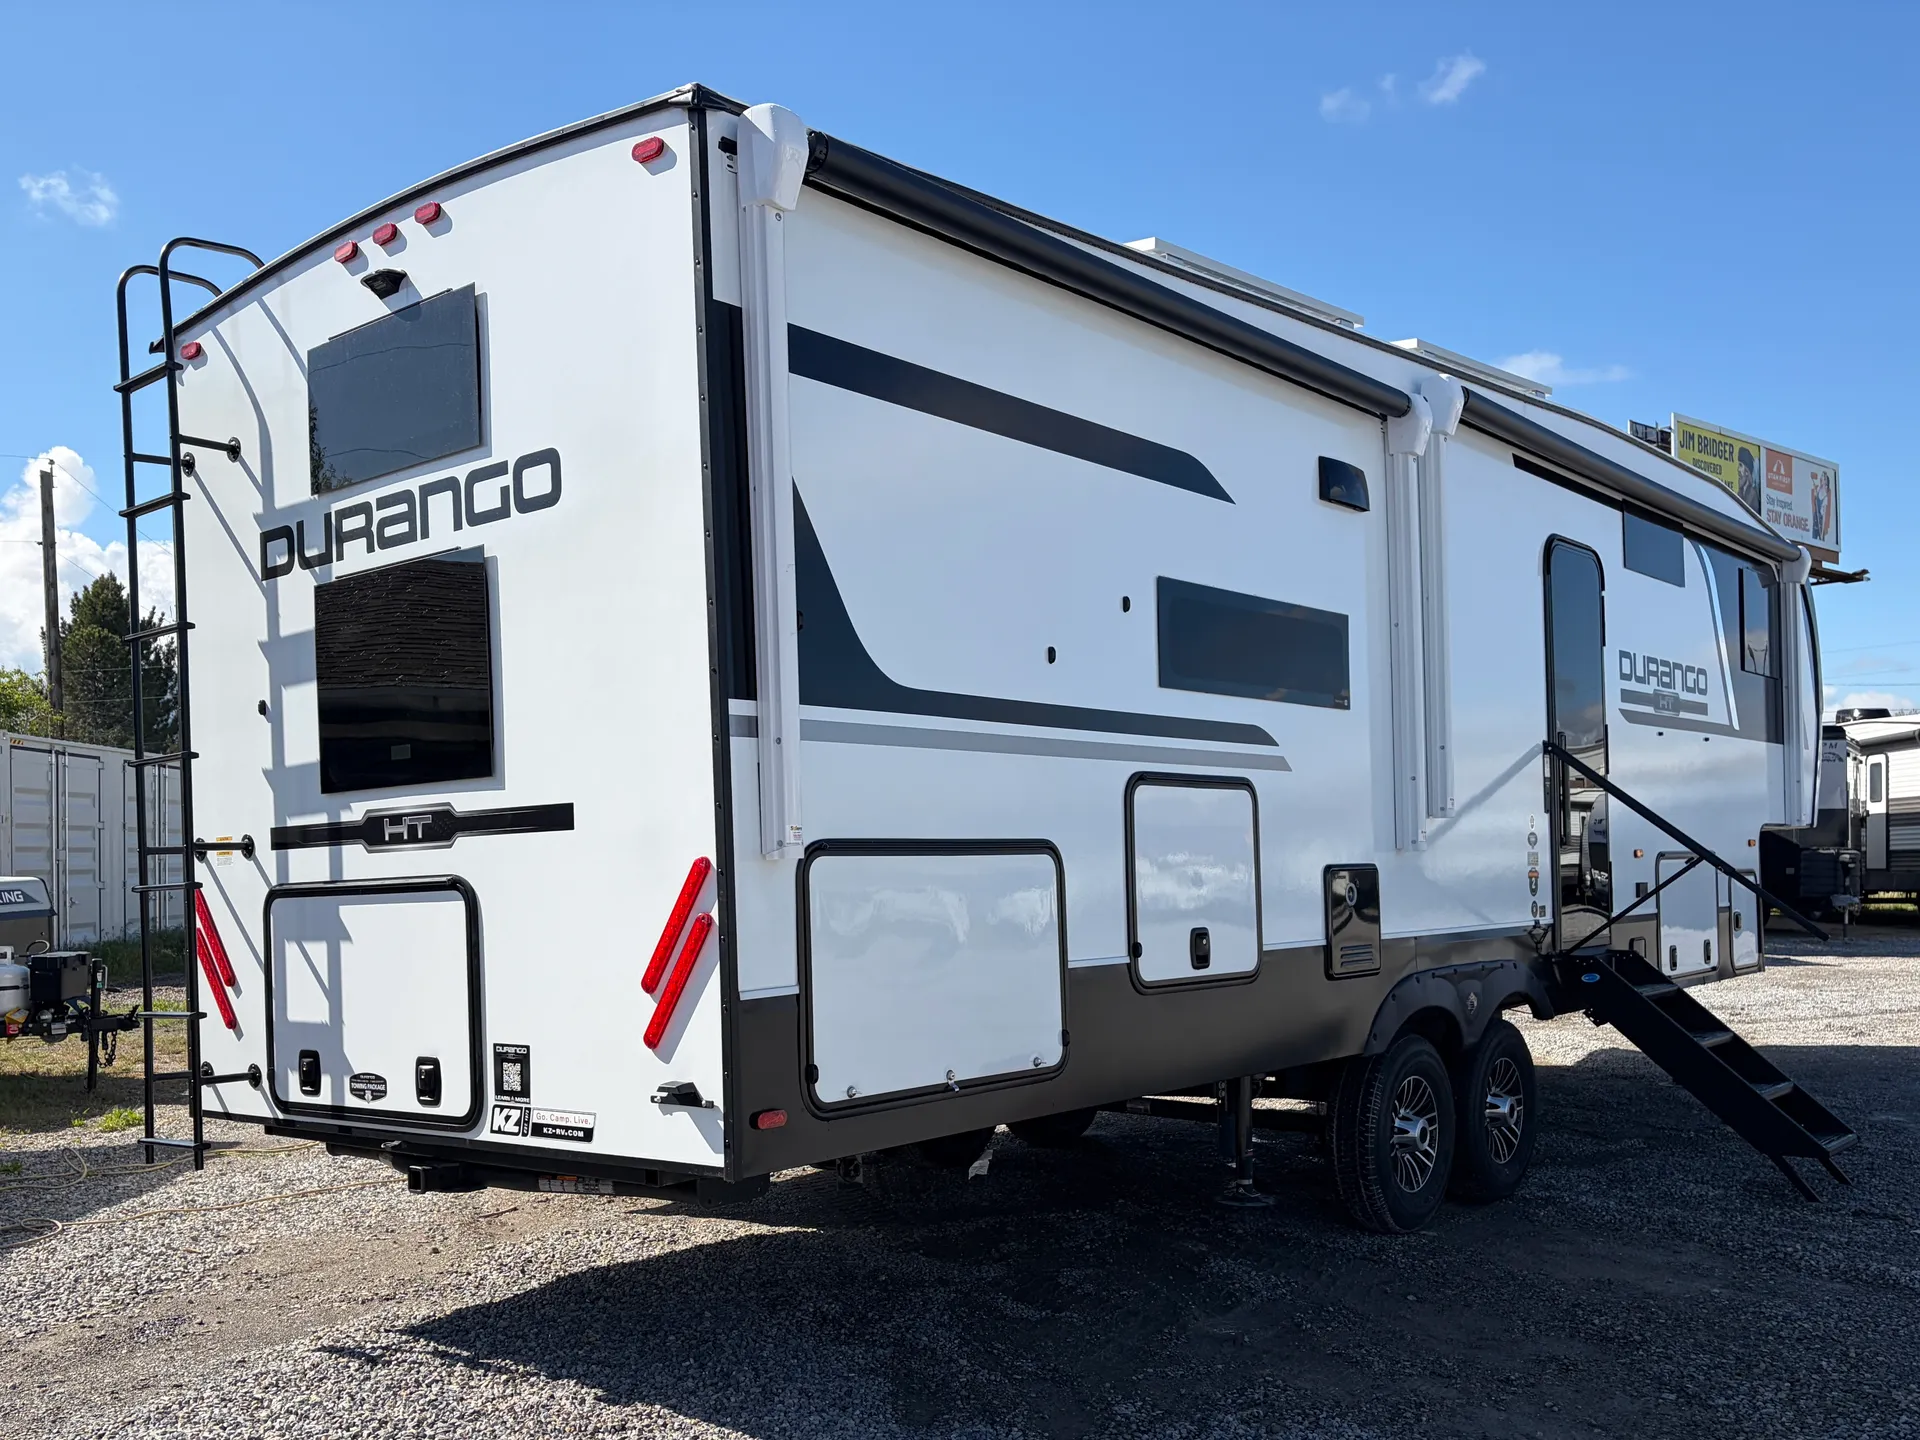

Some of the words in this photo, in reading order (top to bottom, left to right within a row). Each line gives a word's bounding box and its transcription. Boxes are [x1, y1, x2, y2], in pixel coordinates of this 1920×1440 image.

[1680, 429, 1695, 452] JIM
[1697, 434, 1735, 463] BRIDGER
[1692, 458, 1723, 476] DISCOVERED
[260, 447, 562, 581] DURANGO
[1767, 509, 1782, 524] STAY
[1619, 649, 1707, 696] DURANGO
[1659, 694, 1674, 710] HT
[384, 815, 432, 841] HT
[496, 1045, 527, 1055] DURANGO
[351, 1082, 367, 1090] TOWING
[367, 1083, 386, 1091] PACKAGE
[492, 1107, 521, 1133] KZ
[536, 1112, 548, 1121] Go.
[549, 1113, 572, 1124] Camp.
[573, 1115, 591, 1126] Live.
[543, 1126, 585, 1138] KZ-RV.COM
